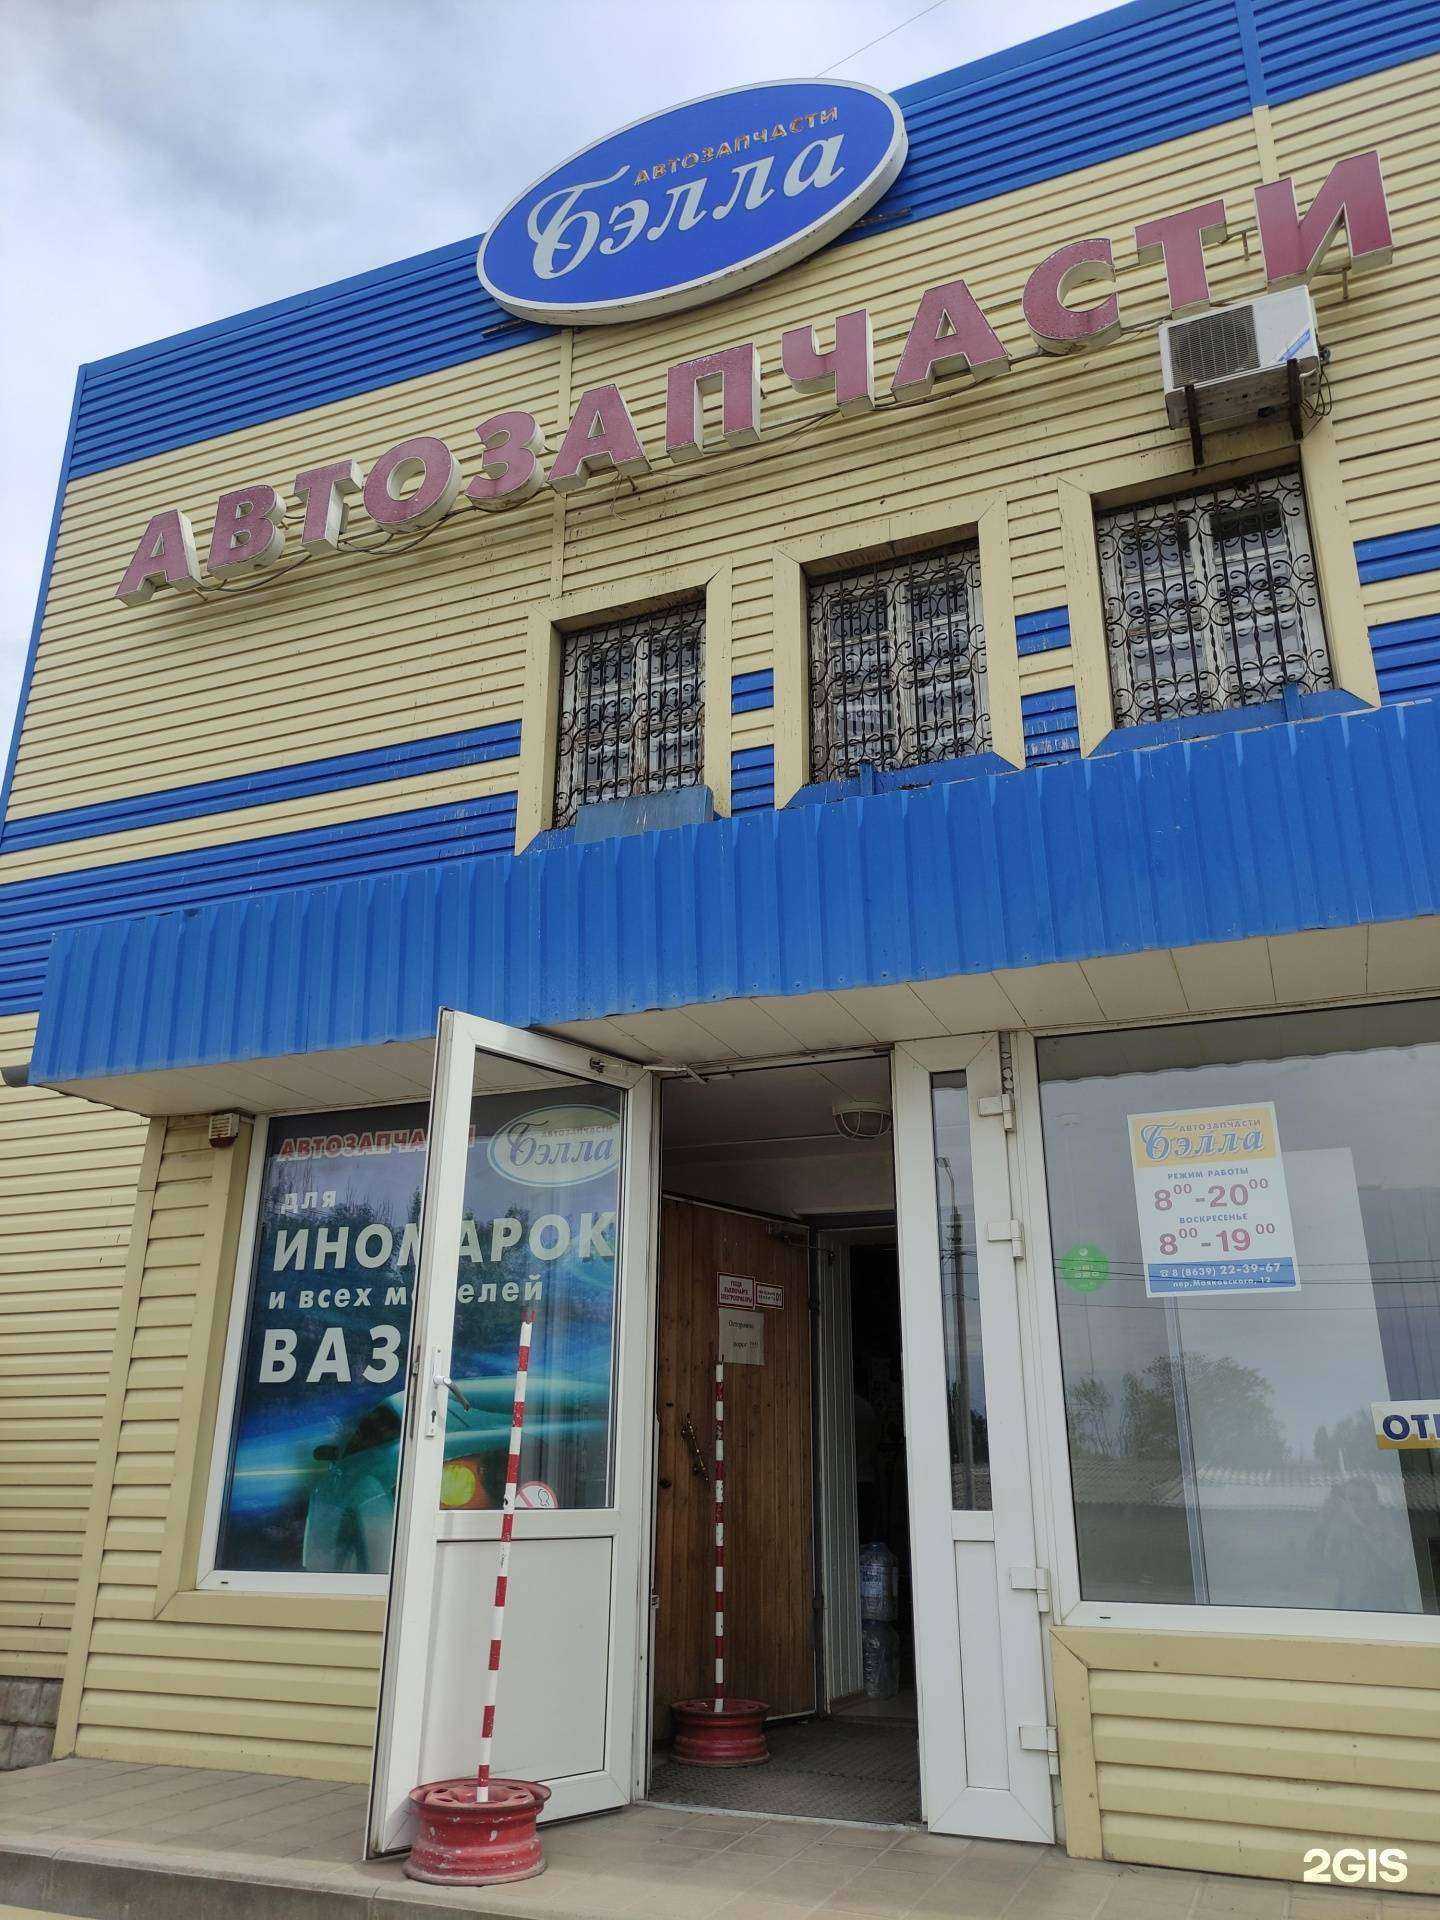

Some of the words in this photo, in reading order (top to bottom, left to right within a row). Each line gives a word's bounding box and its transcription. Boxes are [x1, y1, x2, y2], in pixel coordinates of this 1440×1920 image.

[632, 106, 839, 186] АВТОЗАПЧАСТИ
[526, 133, 846, 280] Бэлла
[115, 151, 1393, 606] АВТОЗАПЧАСТИ
[277, 1124, 476, 1161] АВТОЗАПЧА
[507, 1120, 613, 1166] Бэлла
[1140, 1120, 1265, 1160] Бэлла
[1179, 1119, 1261, 1132] АВТОЗАПЧАСТИ
[1167, 1170, 1204, 1180] РЕЖИМ
[1208, 1167, 1249, 1177] РАБОТЫ
[1179, 1213, 1248, 1223] ВОСКРЕСЕНЬЕ
[1220, 1262, 1281, 1275] 22-39-67
[268, 1290, 286, 1310] и
[299, 1286, 371, 1308] всех
[385, 1273, 543, 1306] мелей
[258, 1324, 401, 1384] ВАЗ
